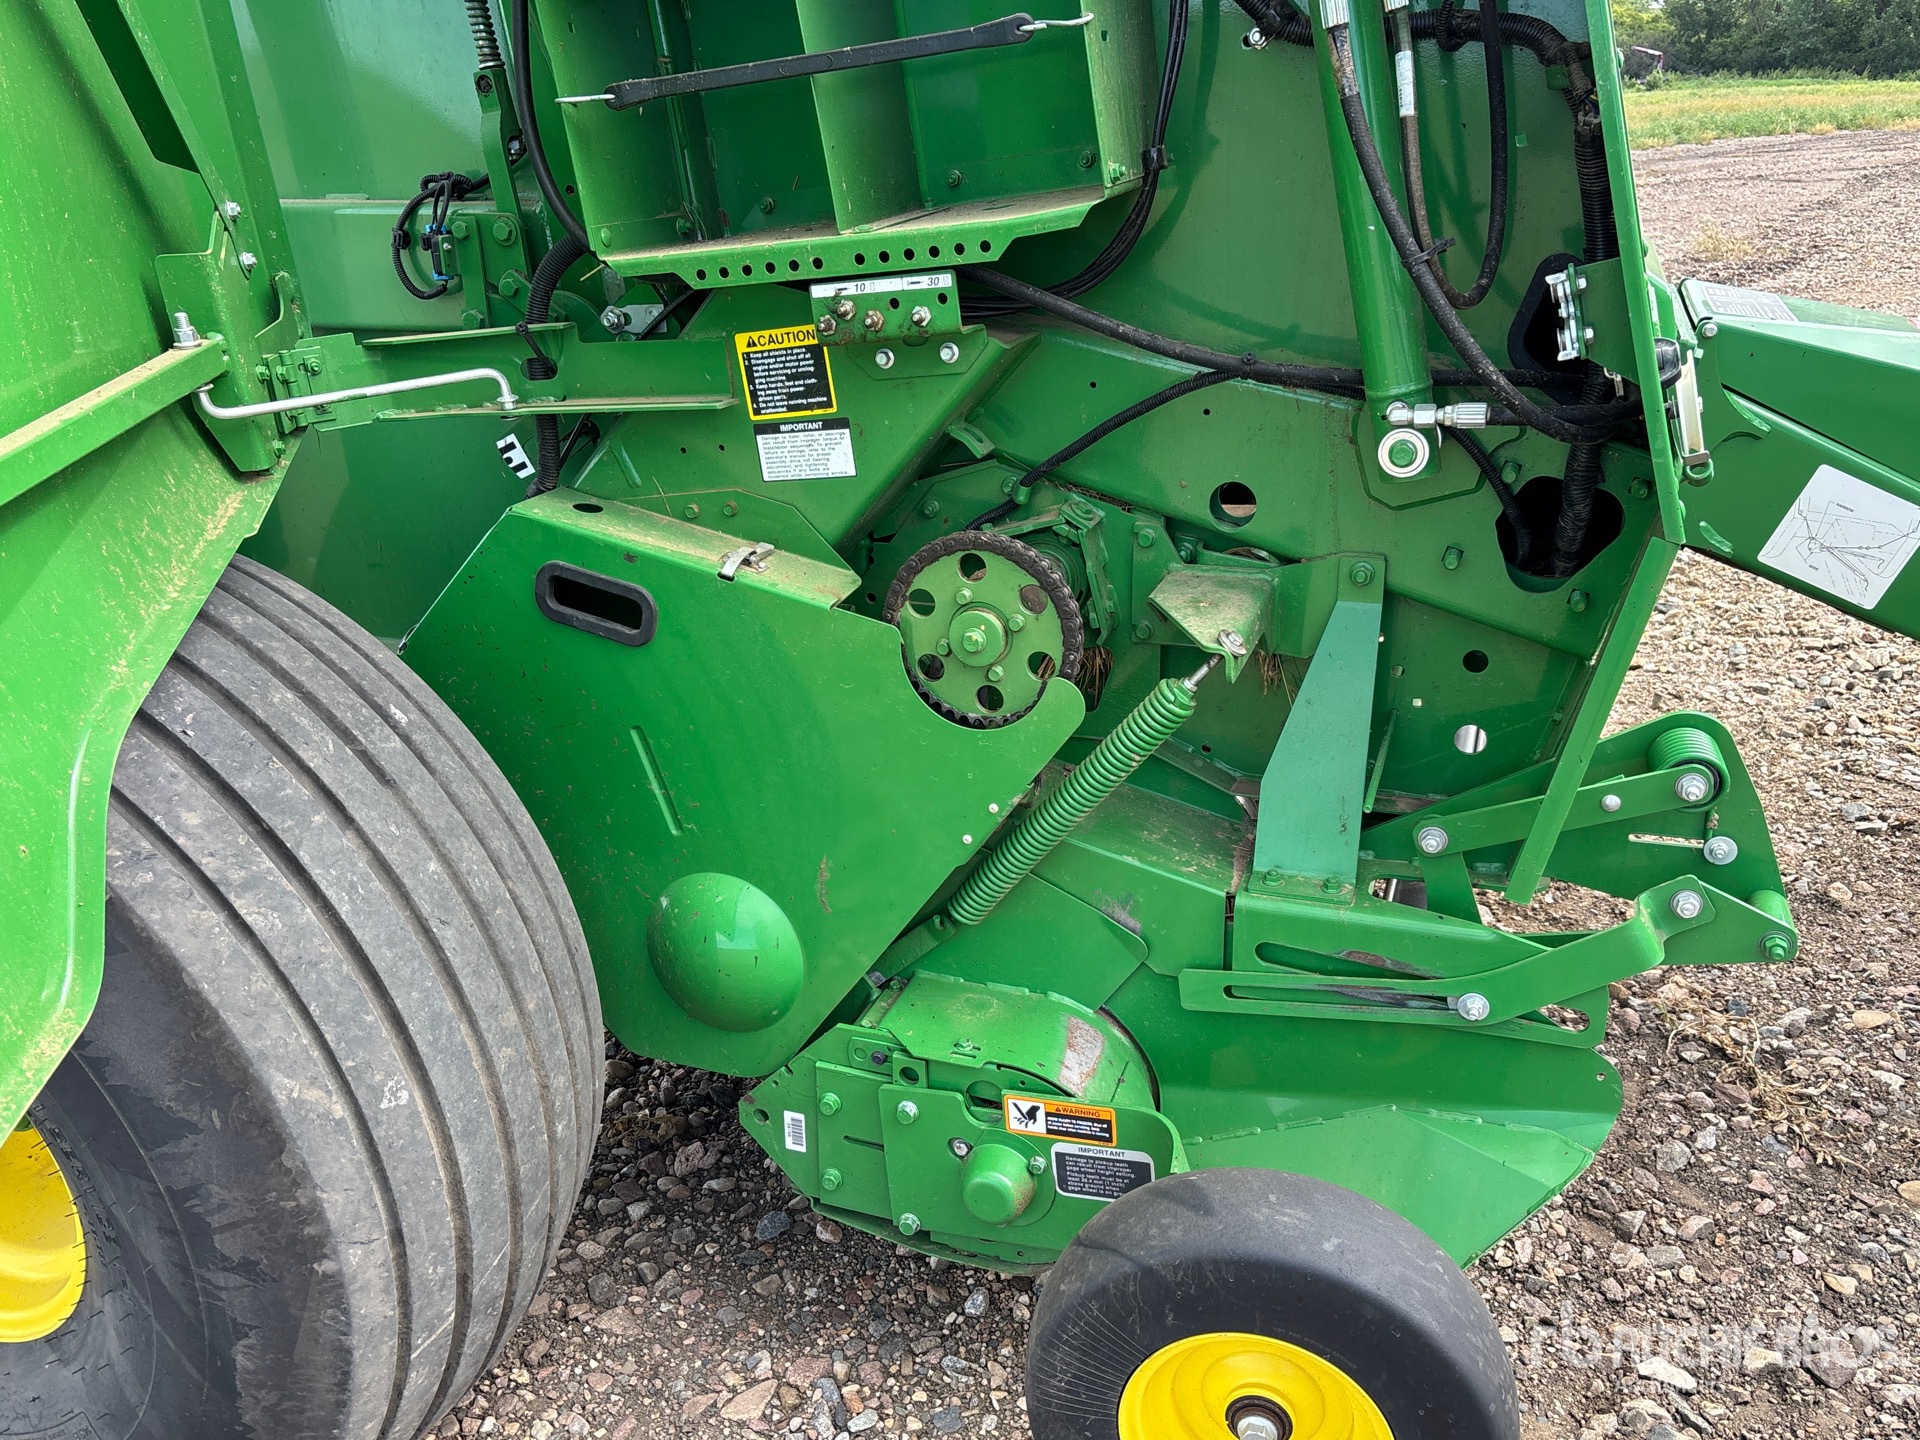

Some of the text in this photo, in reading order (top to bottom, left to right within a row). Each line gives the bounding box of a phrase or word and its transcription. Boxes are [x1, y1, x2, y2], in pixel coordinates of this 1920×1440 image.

[854, 276, 939, 292] 10 30
[756, 328, 815, 346] CAUTION
[750, 357, 775, 365] Disengage
[769, 368, 790, 376] servicing
[797, 365, 815, 373] unclog-
[779, 421, 823, 431] IMPORTANT
[1061, 1107, 1100, 1117] WARNING
[1078, 1146, 1125, 1157] IMPORTANT
[1107, 1165, 1131, 1173] improper
